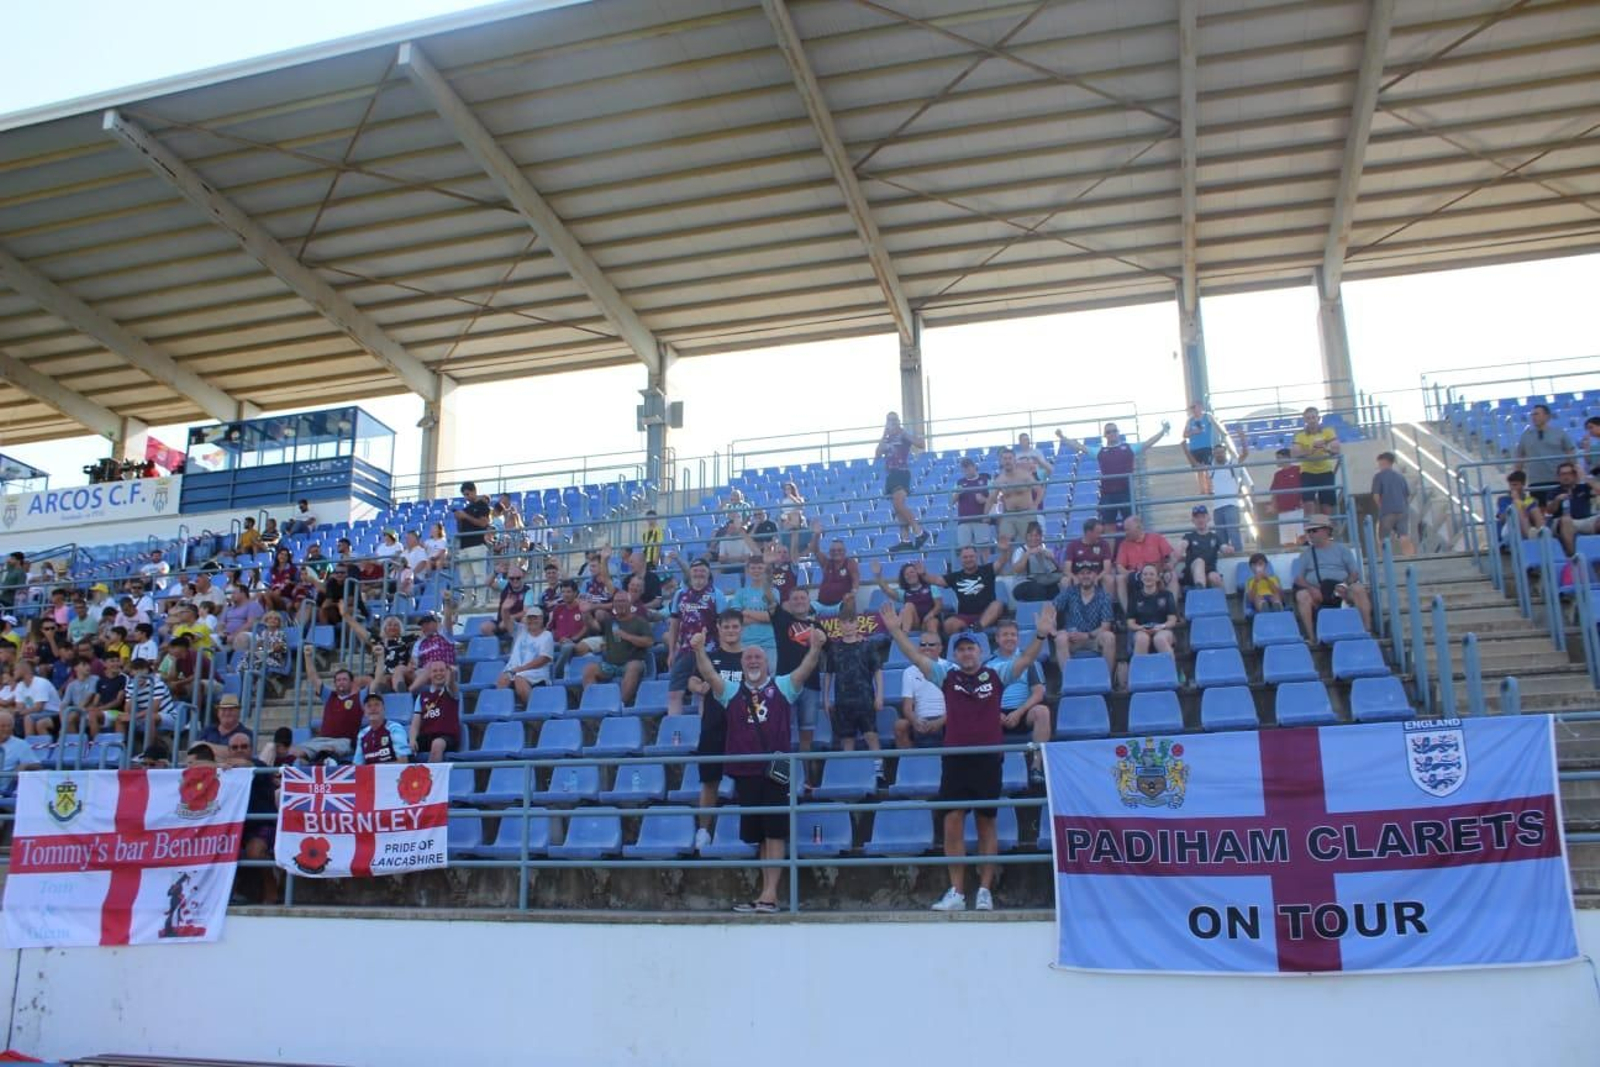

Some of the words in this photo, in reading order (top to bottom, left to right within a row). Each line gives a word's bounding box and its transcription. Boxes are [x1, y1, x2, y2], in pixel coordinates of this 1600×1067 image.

[28, 488, 103, 515] ARCOS
[109, 483, 146, 506] C.F.
[1404, 718, 1461, 730] ENGLAND
[308, 784, 332, 794] 1882
[304, 808, 424, 833] BURNLEY
[385, 842, 416, 854] PRIDE
[418, 839, 434, 851] OF
[1065, 828, 1290, 864] PADIHAM
[1306, 810, 1546, 861] CLARETS
[20, 836, 108, 871] Tommy's
[114, 835, 148, 863] bar
[153, 829, 238, 861] Benimar
[372, 852, 444, 867] LANCASHIRE
[1187, 904, 1260, 940] ON
[1277, 900, 1429, 940] TOUR
